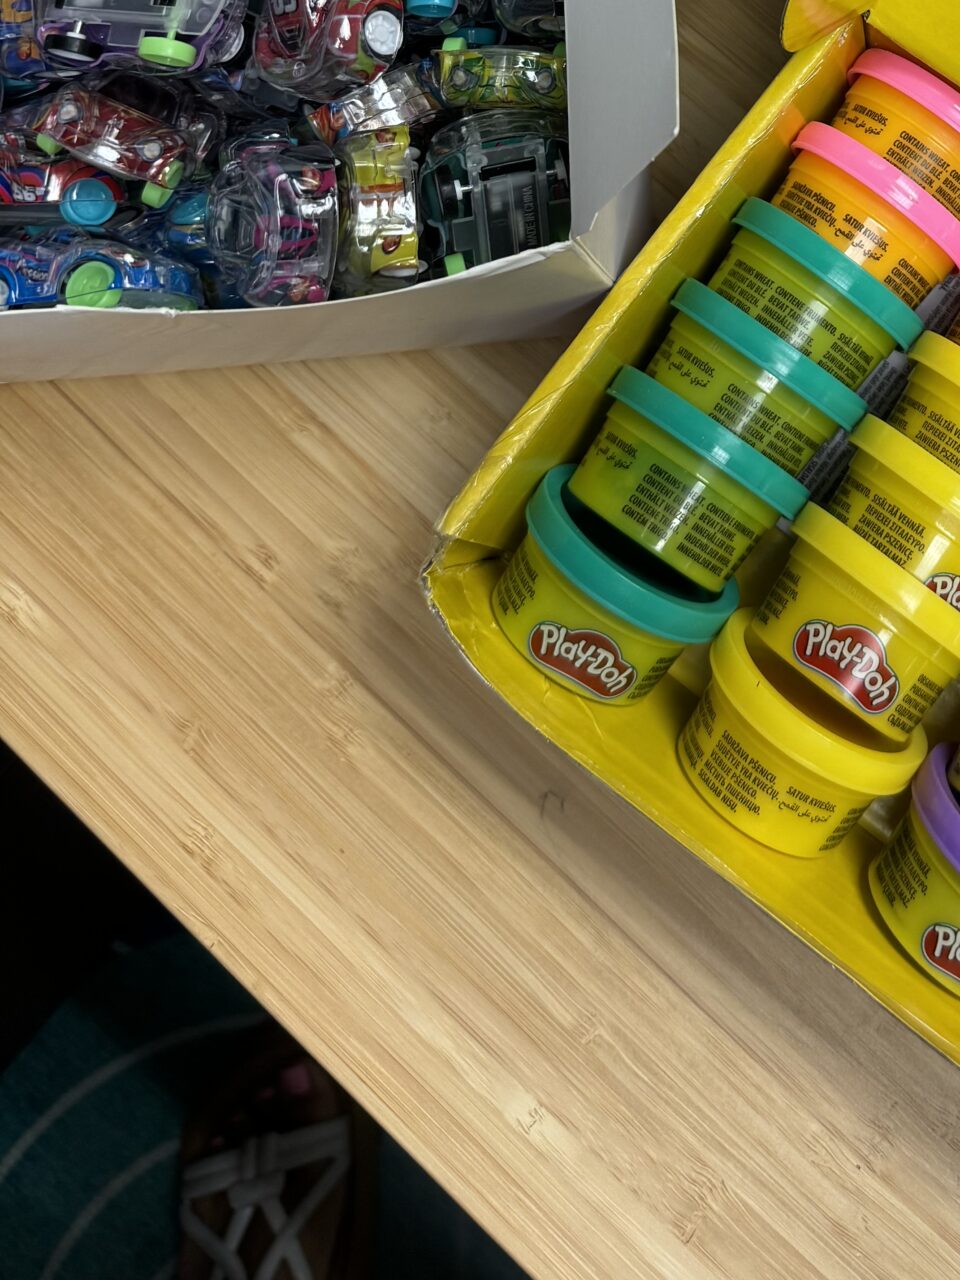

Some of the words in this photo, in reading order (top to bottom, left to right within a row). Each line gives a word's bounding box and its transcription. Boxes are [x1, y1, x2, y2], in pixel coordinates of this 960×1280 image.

[900, 131, 930, 155] CONTAINS
[927, 149, 950, 171] WHEAT.
[752, 271, 773, 291] WHEAT.
[775, 286, 806, 312] CONTIENE
[803, 307, 836, 336] FRUMENTO.
[539, 624, 634, 693] Play-Doh
[805, 623, 896, 707] Play-Doh
[698, 768, 722, 797] SISALDAB
[721, 794, 737, 813] NISU.
